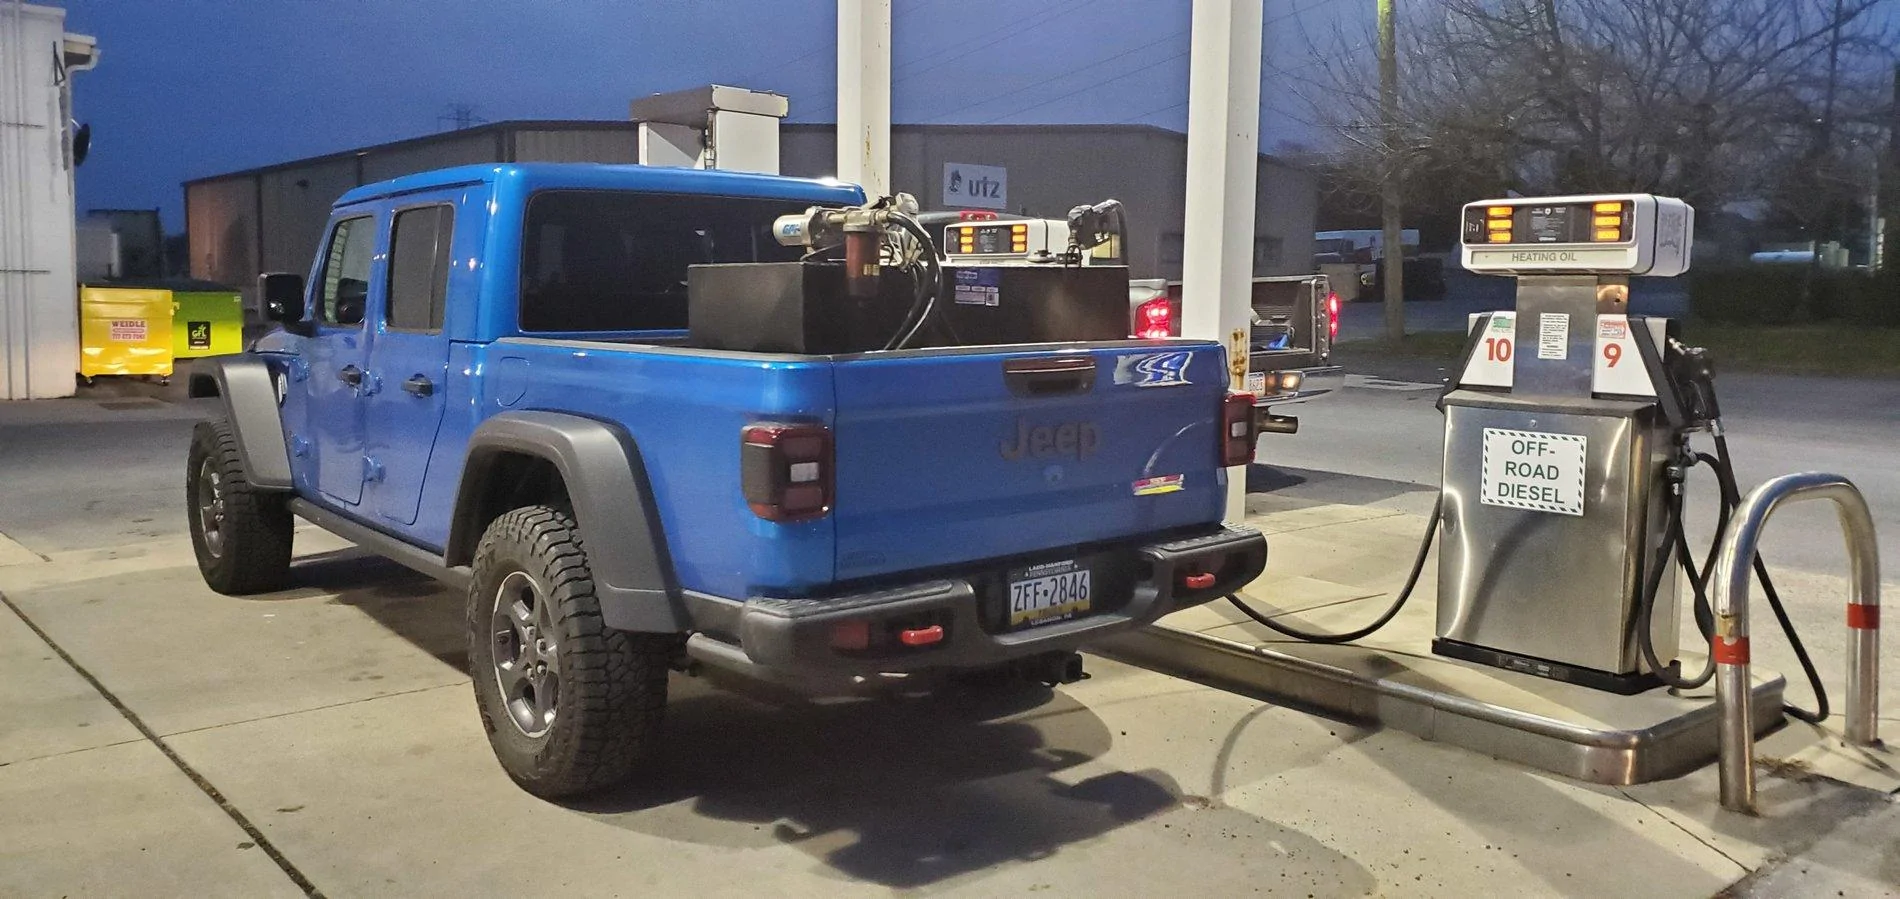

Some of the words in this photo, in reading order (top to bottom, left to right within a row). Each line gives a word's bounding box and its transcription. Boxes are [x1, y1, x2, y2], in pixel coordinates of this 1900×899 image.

[1512, 253, 1557, 262] HEATING
[1560, 252, 1577, 261] OIL
[112, 320, 146, 328] WEIDLE
[1485, 338, 1512, 362] 10
[1603, 343, 1622, 368] 9
[1000, 416, 1102, 463] Jeep
[1512, 440, 1556, 456] OFF-
[1505, 461, 1559, 480] ROAD
[1498, 482, 1565, 504] DIESEL
